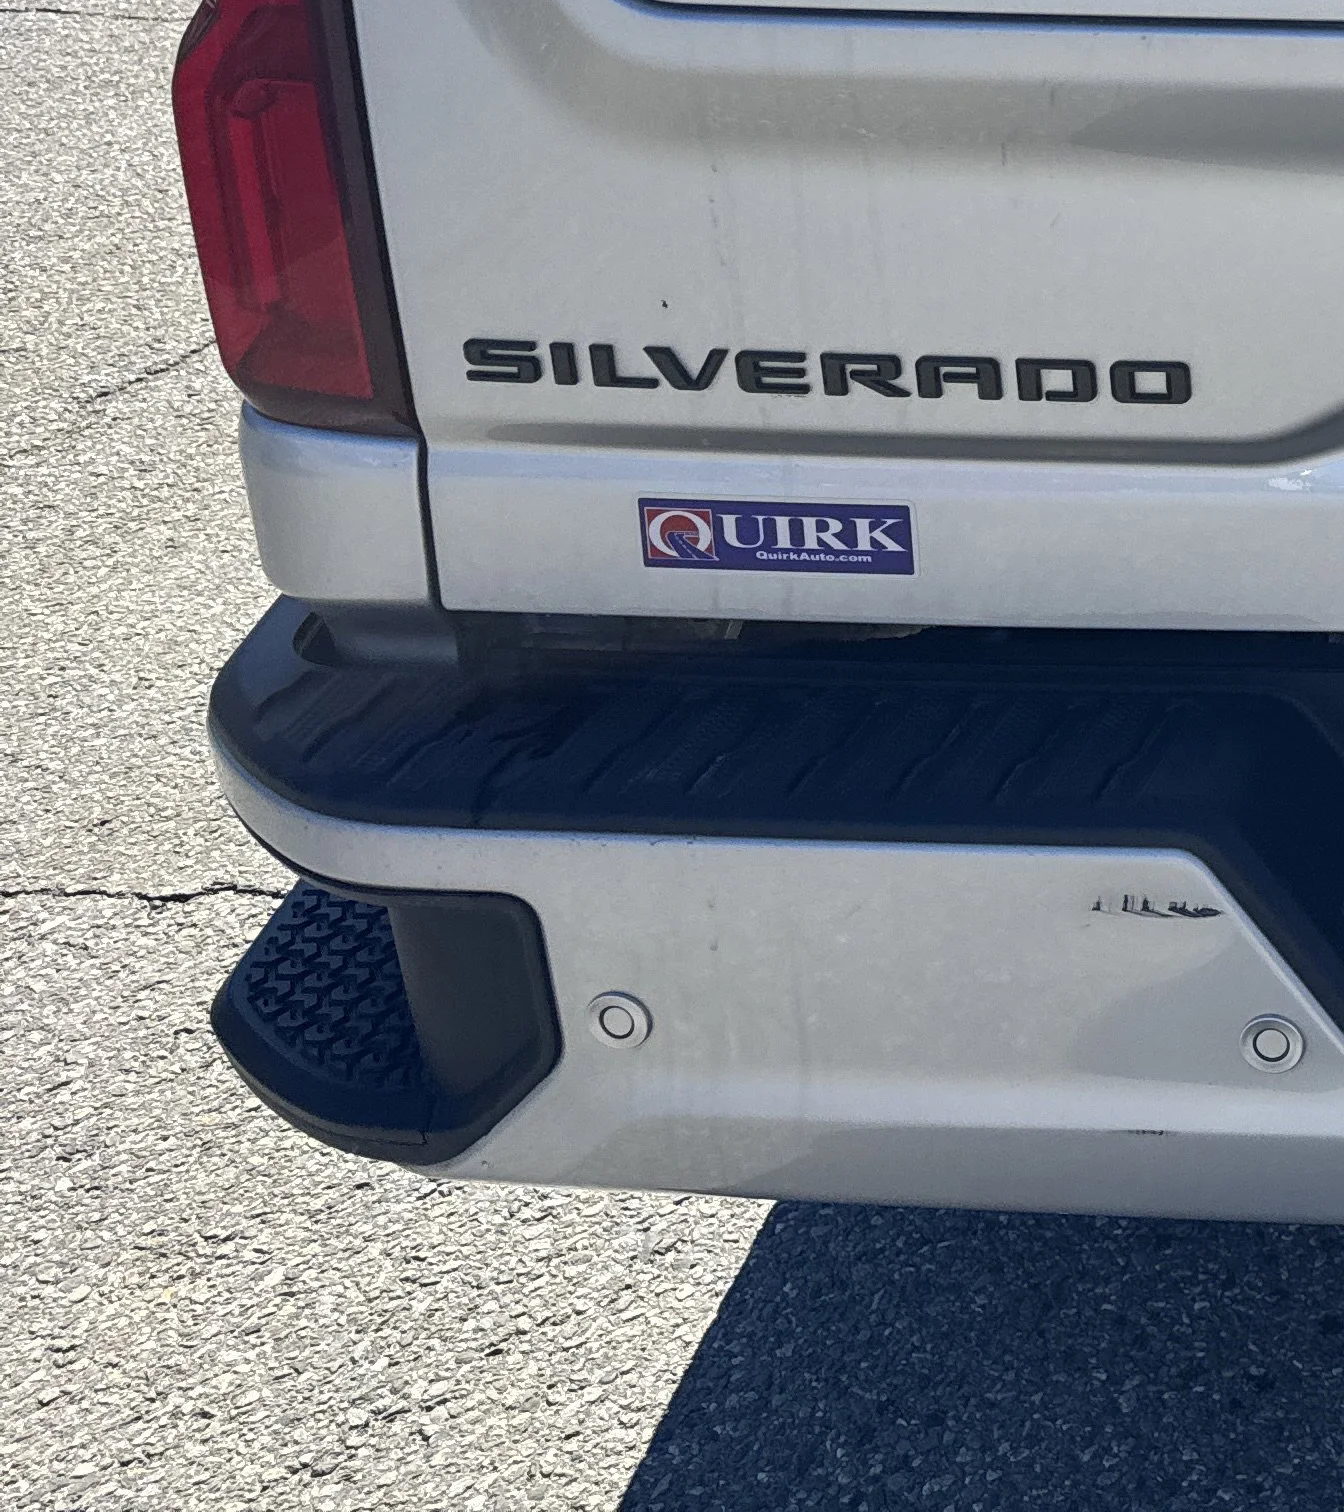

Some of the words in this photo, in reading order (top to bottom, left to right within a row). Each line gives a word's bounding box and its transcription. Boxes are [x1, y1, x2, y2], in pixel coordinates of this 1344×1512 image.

[463, 337, 1193, 405] SILVERADO
[649, 510, 908, 561] QUIRK
[755, 550, 873, 564] QuirkAuto.com
